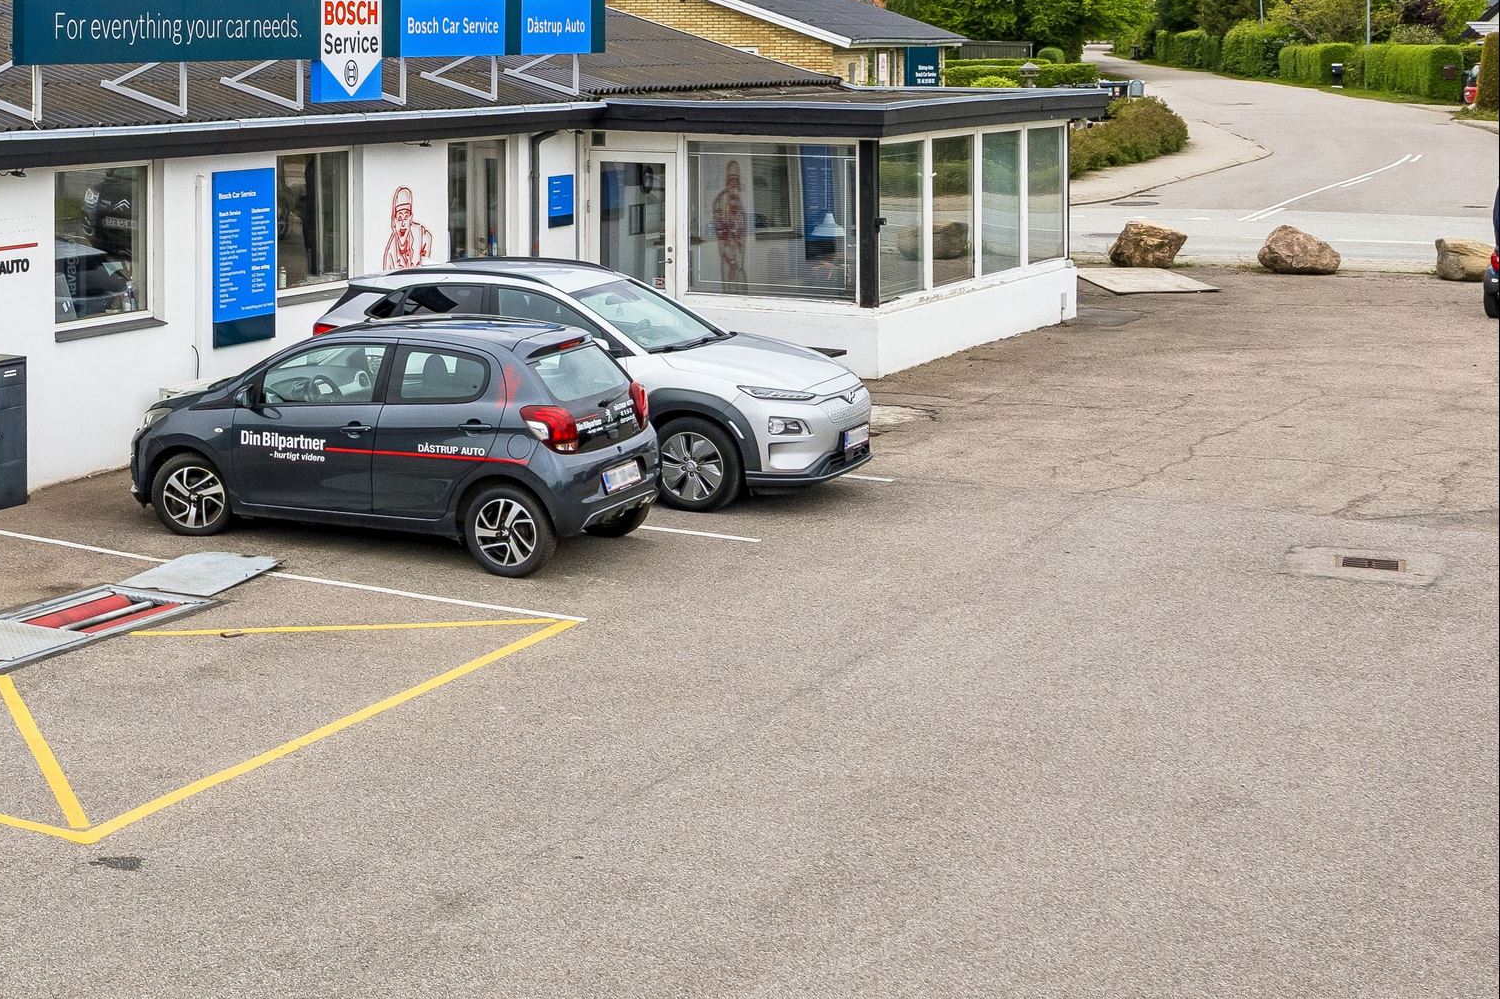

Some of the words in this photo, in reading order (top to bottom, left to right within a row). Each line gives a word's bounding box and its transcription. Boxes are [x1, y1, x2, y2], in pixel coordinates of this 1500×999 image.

[324, 1, 378, 25] BOSCH
[55, 12, 86, 40] For
[90, 12, 182, 45] everything
[186, 19, 223, 44] your
[225, 19, 250, 39] car
[253, 13, 302, 38] needs.
[407, 16, 439, 34] Bosch
[442, 17, 459, 34] Car
[462, 17, 499, 34] Service
[527, 17, 563, 36] Dåstrup
[565, 18, 586, 33] Auto
[324, 31, 379, 54] Service
[219, 192, 232, 200] Bosch
[240, 430, 261, 446] Din
[262, 431, 327, 451] Bilpartner
[417, 442, 458, 454] DÅSTRUP
[460, 447, 486, 456] AUTO
[301, 453, 325, 462] videre
